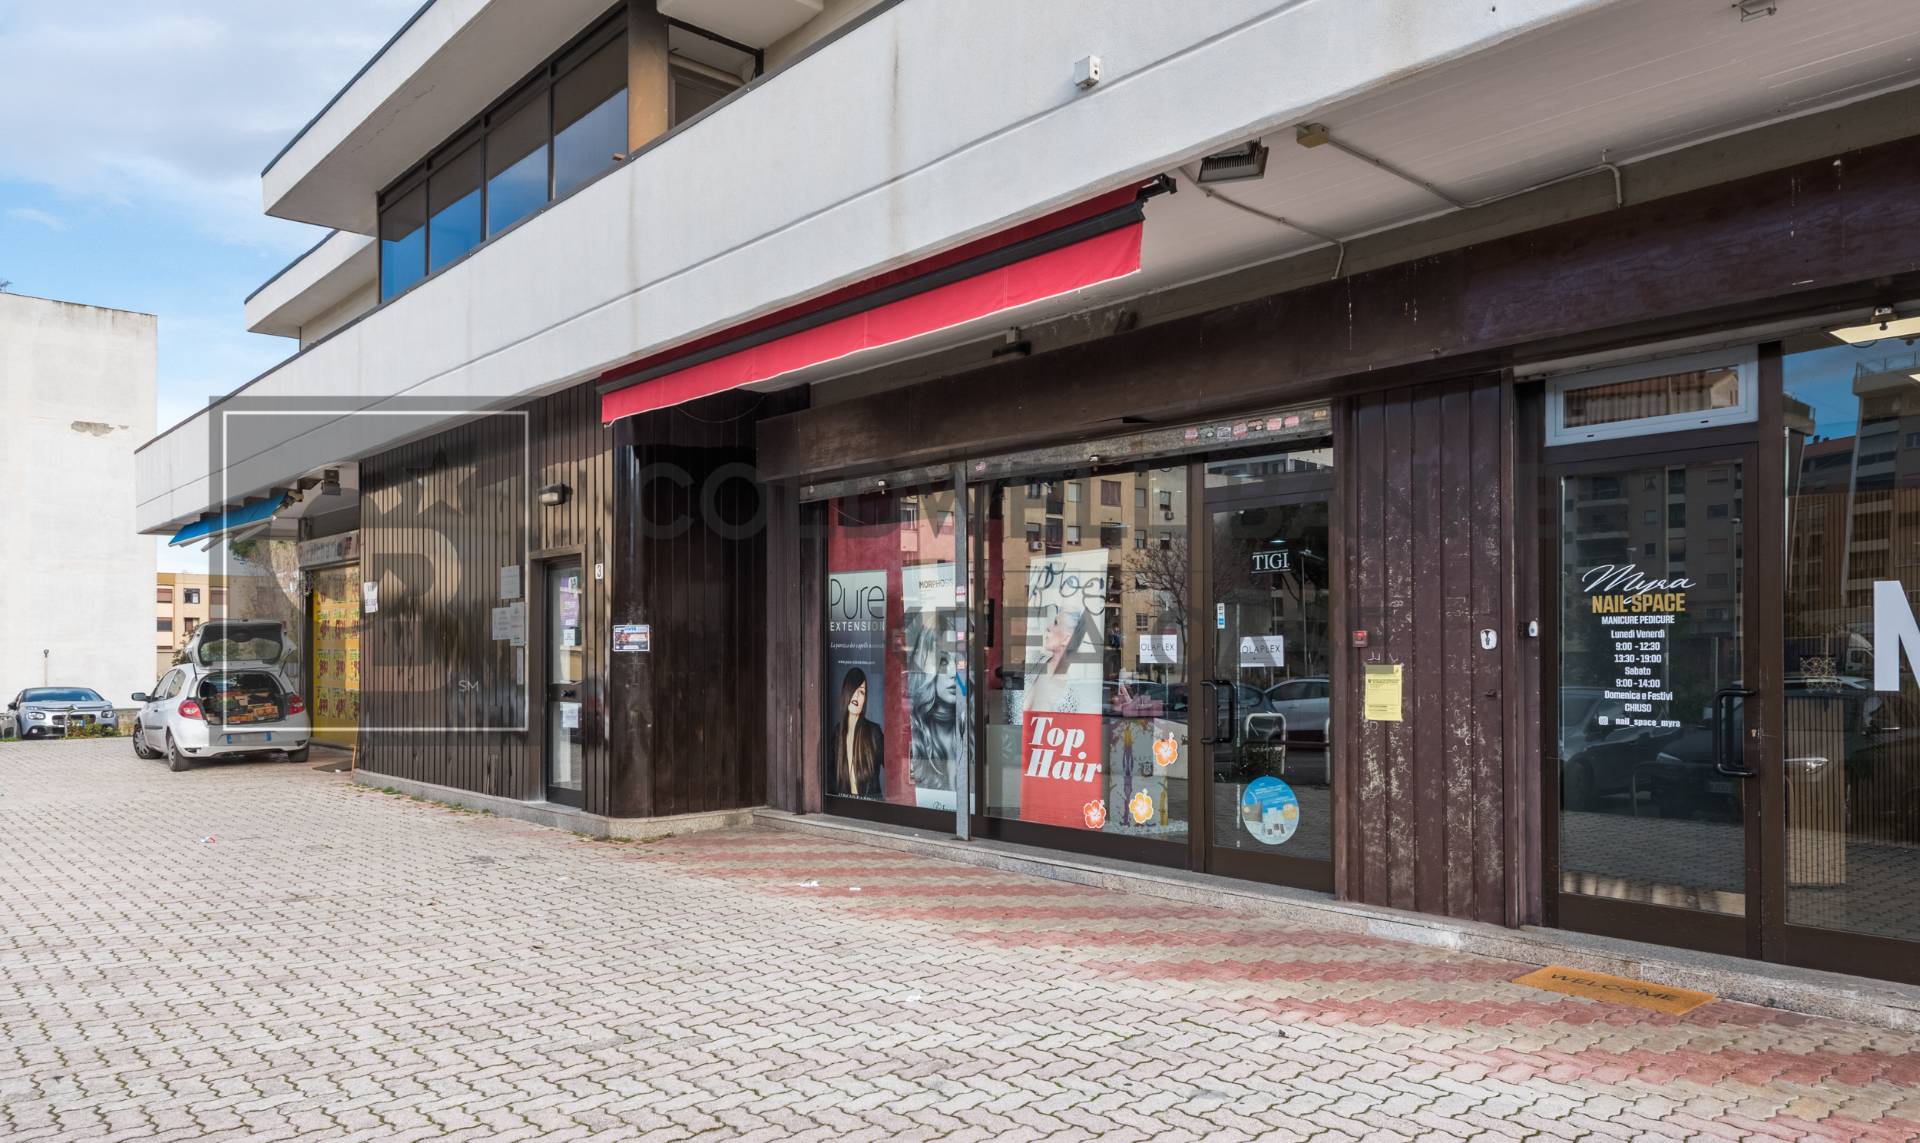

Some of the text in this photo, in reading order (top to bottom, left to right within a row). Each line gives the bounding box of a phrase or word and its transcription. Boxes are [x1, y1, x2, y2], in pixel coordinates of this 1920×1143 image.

[1252, 552, 1288, 571] TIGI
[596, 564, 602, 578] 3
[1582, 564, 1696, 605] Myra
[830, 579, 885, 620] Pure
[1592, 592, 1686, 614] NAIL SPACE
[1601, 614, 1675, 625] MANICURE PEDICURE
[830, 620, 885, 632] EXTENSION
[1141, 642, 1175, 652] OLAPLEX
[1241, 644, 1281, 654] OLAPLEX
[1615, 642, 1632, 651] 9:00
[1640, 642, 1660, 651] 12:30
[1614, 654, 1635, 663] 13:30
[1641, 654, 1662, 663] 19:00
[1624, 666, 1651, 675] Sabato
[1615, 679, 1633, 688] 9:00
[1638, 679, 1660, 688] 14:00
[1604, 690, 1640, 700] Domenica
[1647, 691, 1673, 701] Festivi
[1624, 703, 1652, 712] CHIUSO
[1615, 717, 1681, 728] nail_space_myra
[1028, 716, 1085, 757] Top
[1024, 748, 1102, 783] Hair
[1551, 973, 1681, 1002] WELCOME
